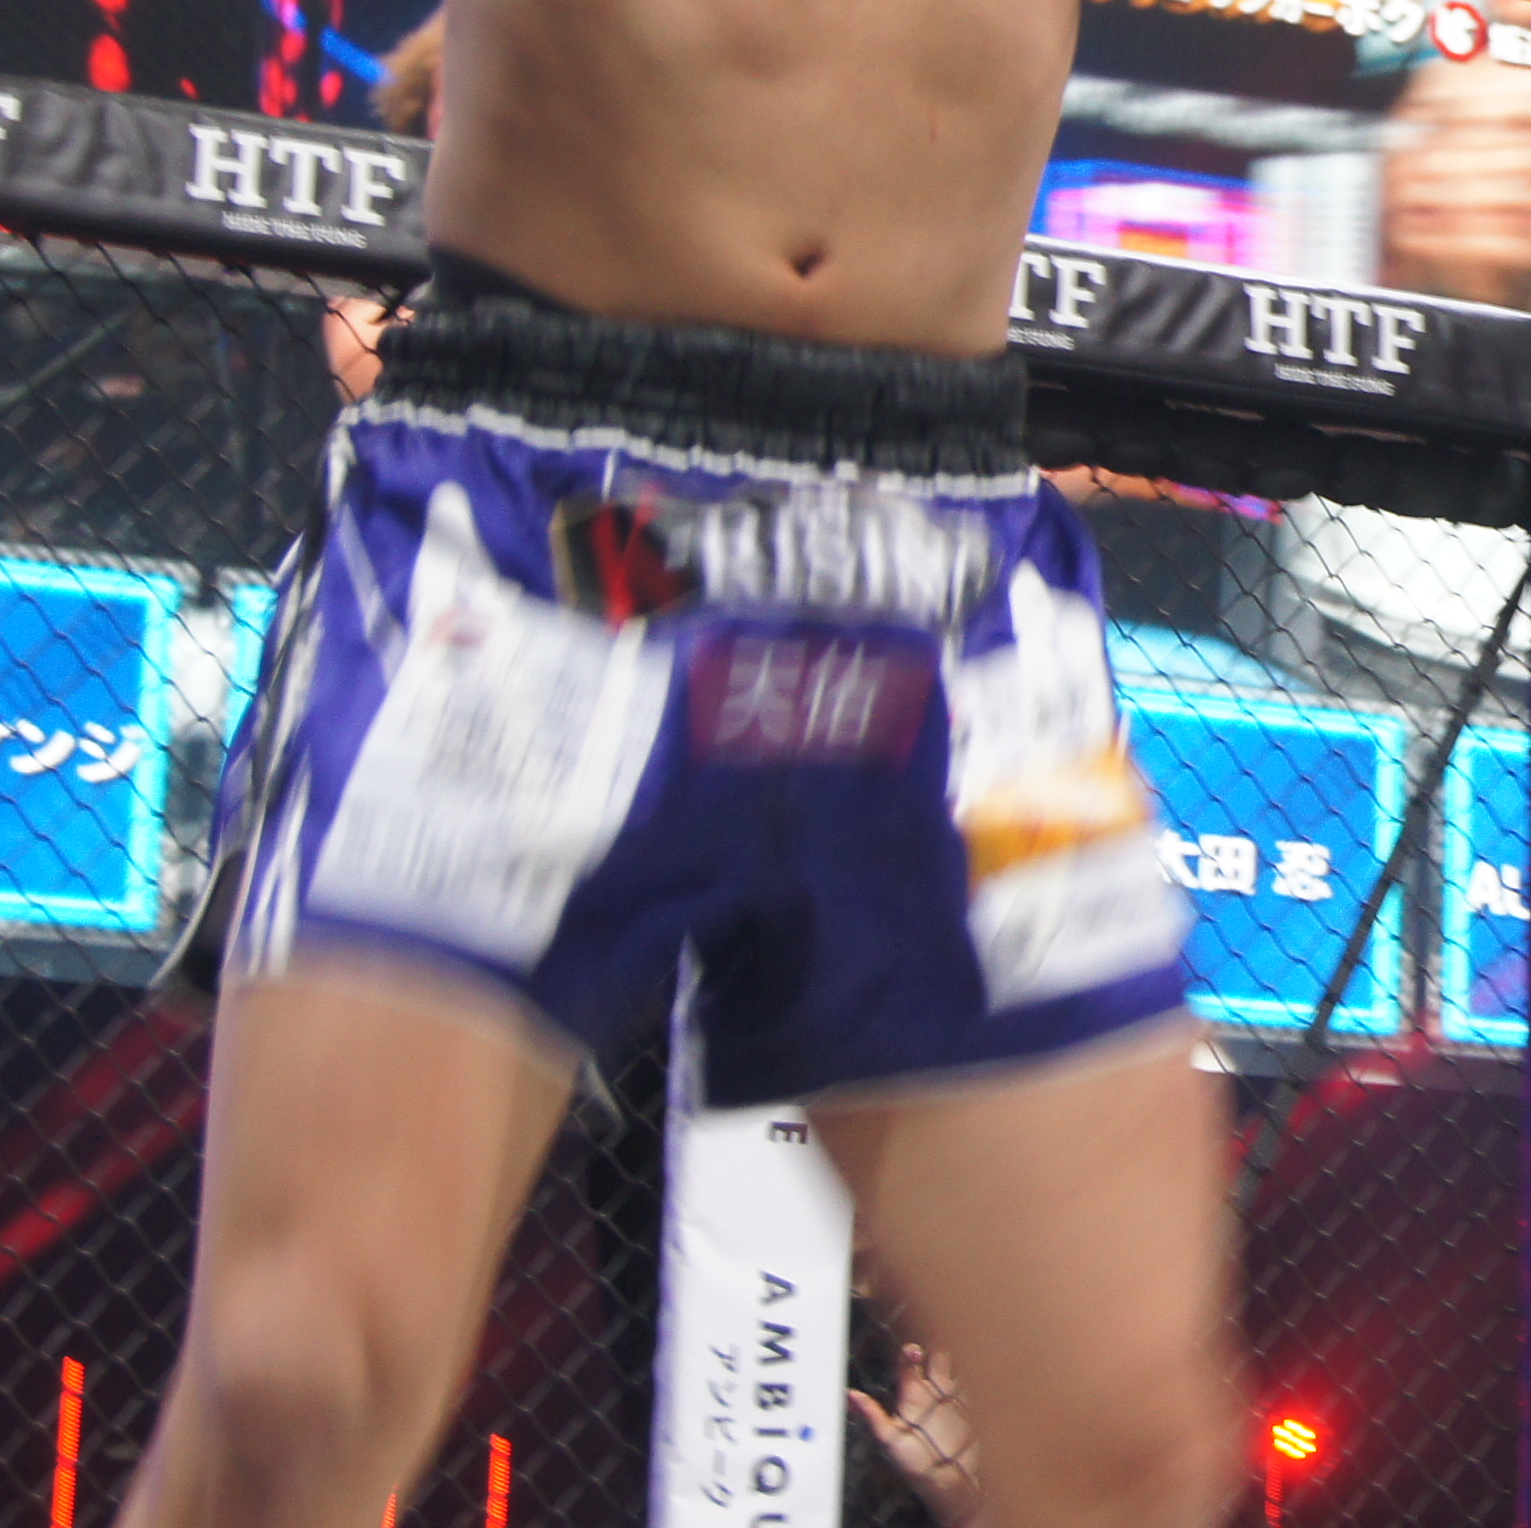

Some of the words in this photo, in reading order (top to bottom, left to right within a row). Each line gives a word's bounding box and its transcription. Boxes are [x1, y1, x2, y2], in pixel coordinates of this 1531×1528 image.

[185, 123, 407, 227] HTF
[1008, 251, 1107, 329] TF
[1243, 282, 1427, 374] HTF
